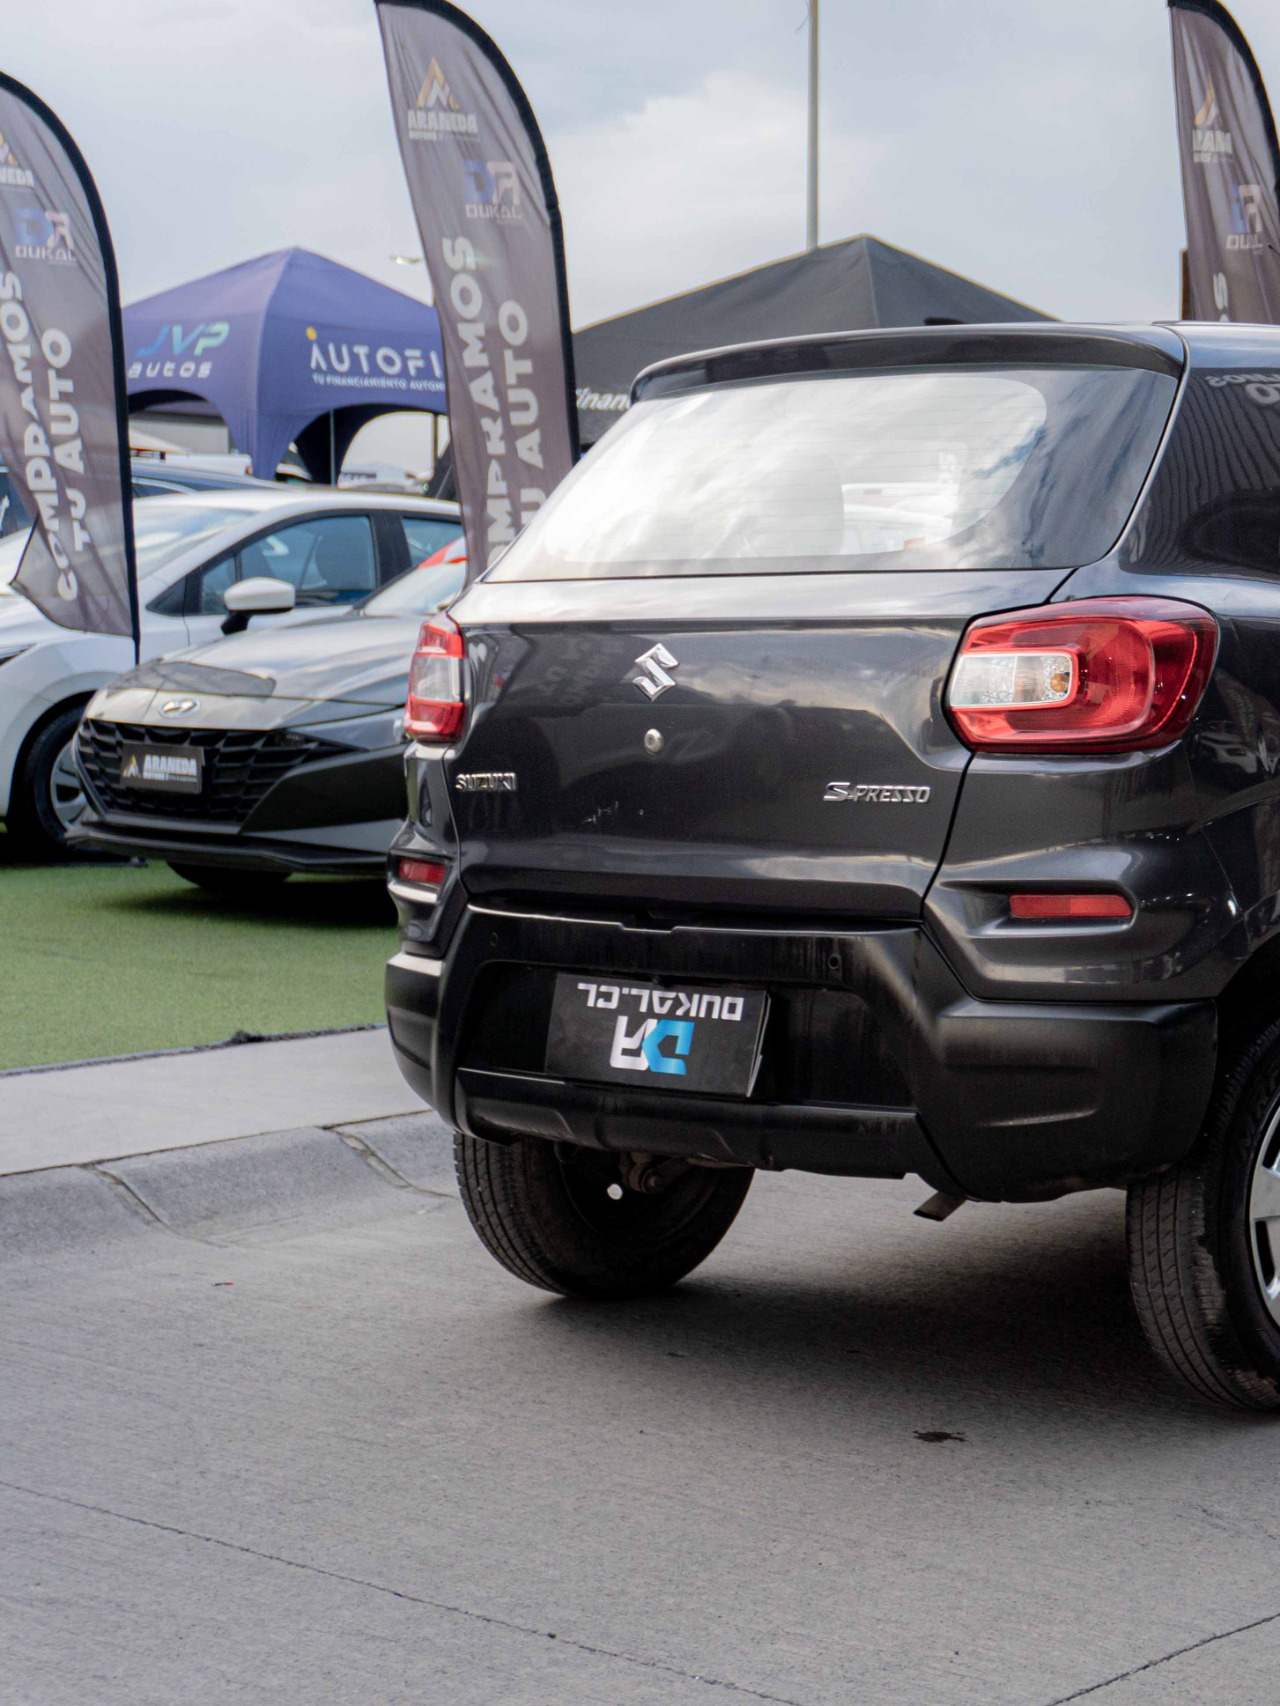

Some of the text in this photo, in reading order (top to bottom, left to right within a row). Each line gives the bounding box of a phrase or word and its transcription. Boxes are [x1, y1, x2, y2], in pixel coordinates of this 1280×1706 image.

[407, 109, 479, 134] ARANEDA
[465, 203, 522, 220] DUKAL
[137, 321, 230, 356] JVP
[312, 373, 324, 385] TU
[410, 380, 446, 392] AUTOM
[499, 300, 545, 470] AUTO
[41, 328, 91, 551] TU AUTO
[143, 754, 198, 776] ARANEDA
[455, 772, 516, 791] SUZUKI
[823, 781, 931, 803] S-PRESSO
[577, 982, 744, 1021] DUKAL.CL
